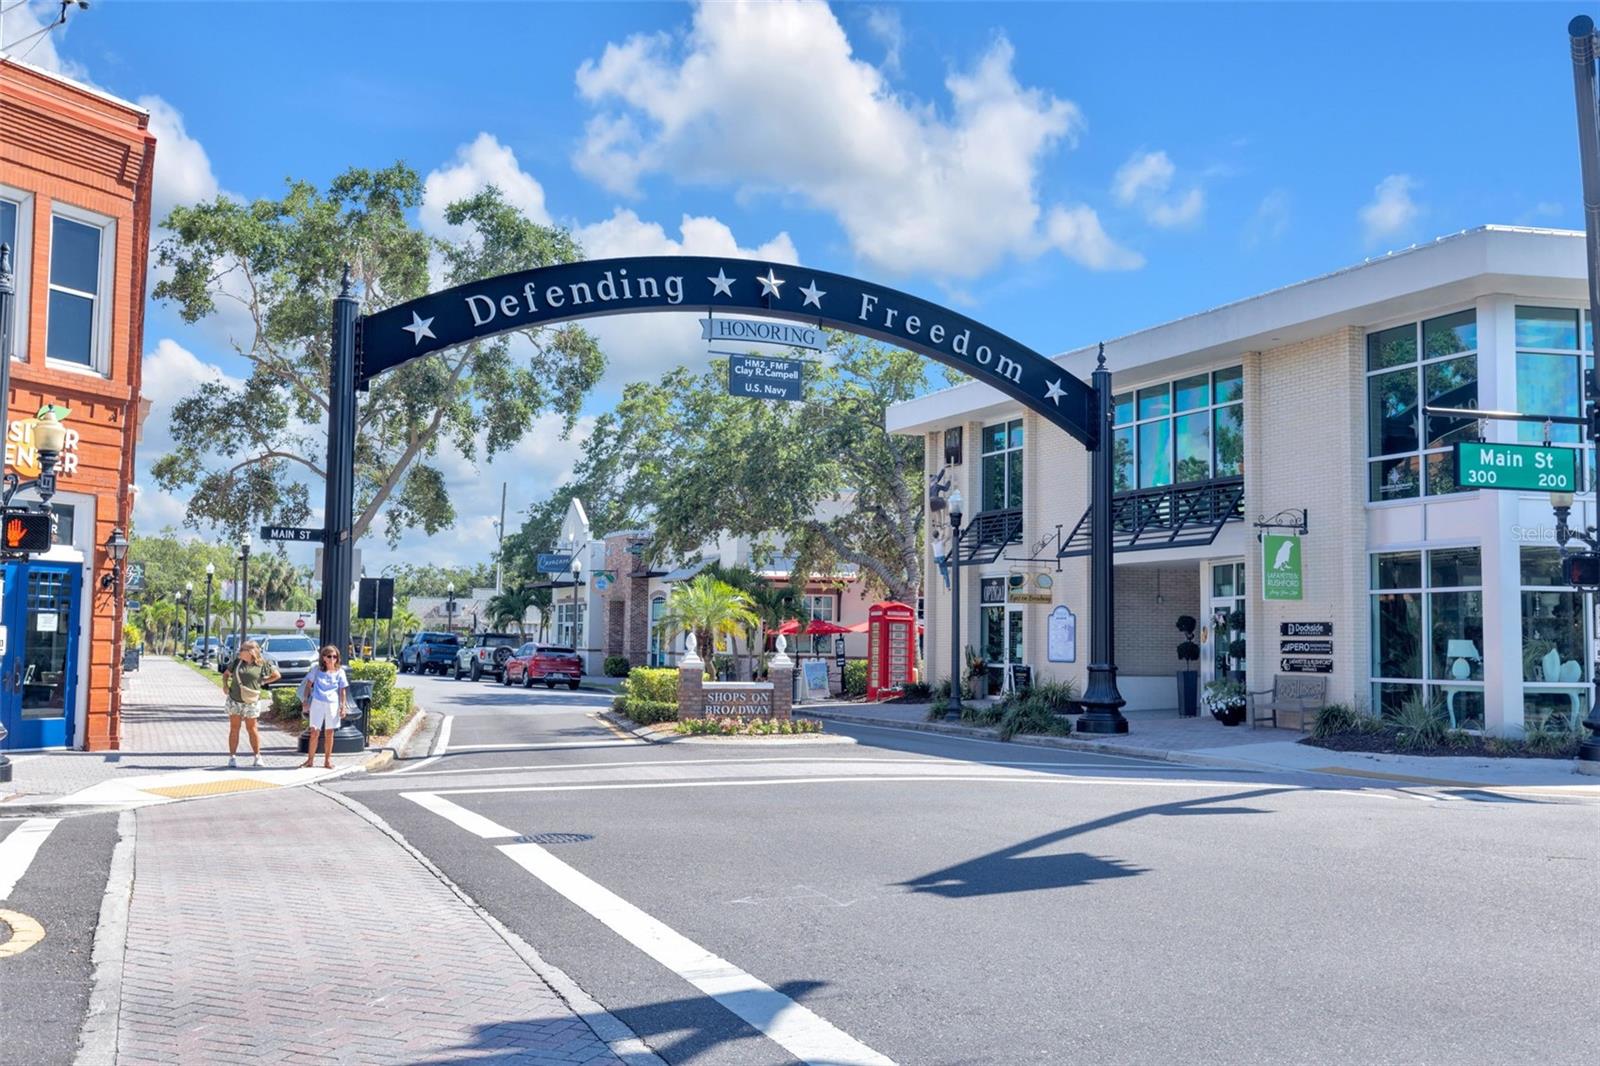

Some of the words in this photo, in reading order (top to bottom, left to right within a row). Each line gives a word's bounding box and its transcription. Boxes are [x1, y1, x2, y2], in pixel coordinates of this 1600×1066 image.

[465, 268, 684, 327] Defending
[858, 292, 1023, 385] Freedom
[720, 321, 815, 345] HONORING
[745, 360, 768, 369] HM2,
[771, 362, 789, 370] FMF
[735, 366, 753, 377] Clay
[756, 368, 764, 376] R.
[765, 370, 799, 380] Campell
[744, 383, 762, 394] U.S.
[764, 384, 787, 398] Navy
[1480, 448, 1523, 468] Main
[1534, 451, 1554, 469] St
[1468, 469, 1497, 484] 300
[1538, 473, 1567, 487] 200
[271, 529, 295, 539] MAIN
[299, 530, 312, 540] ST
[1295, 623, 1323, 632] Dockside
[707, 692, 746, 702] SHOPS
[751, 692, 769, 702] ON
[705, 705, 769, 714] BROADWAY
